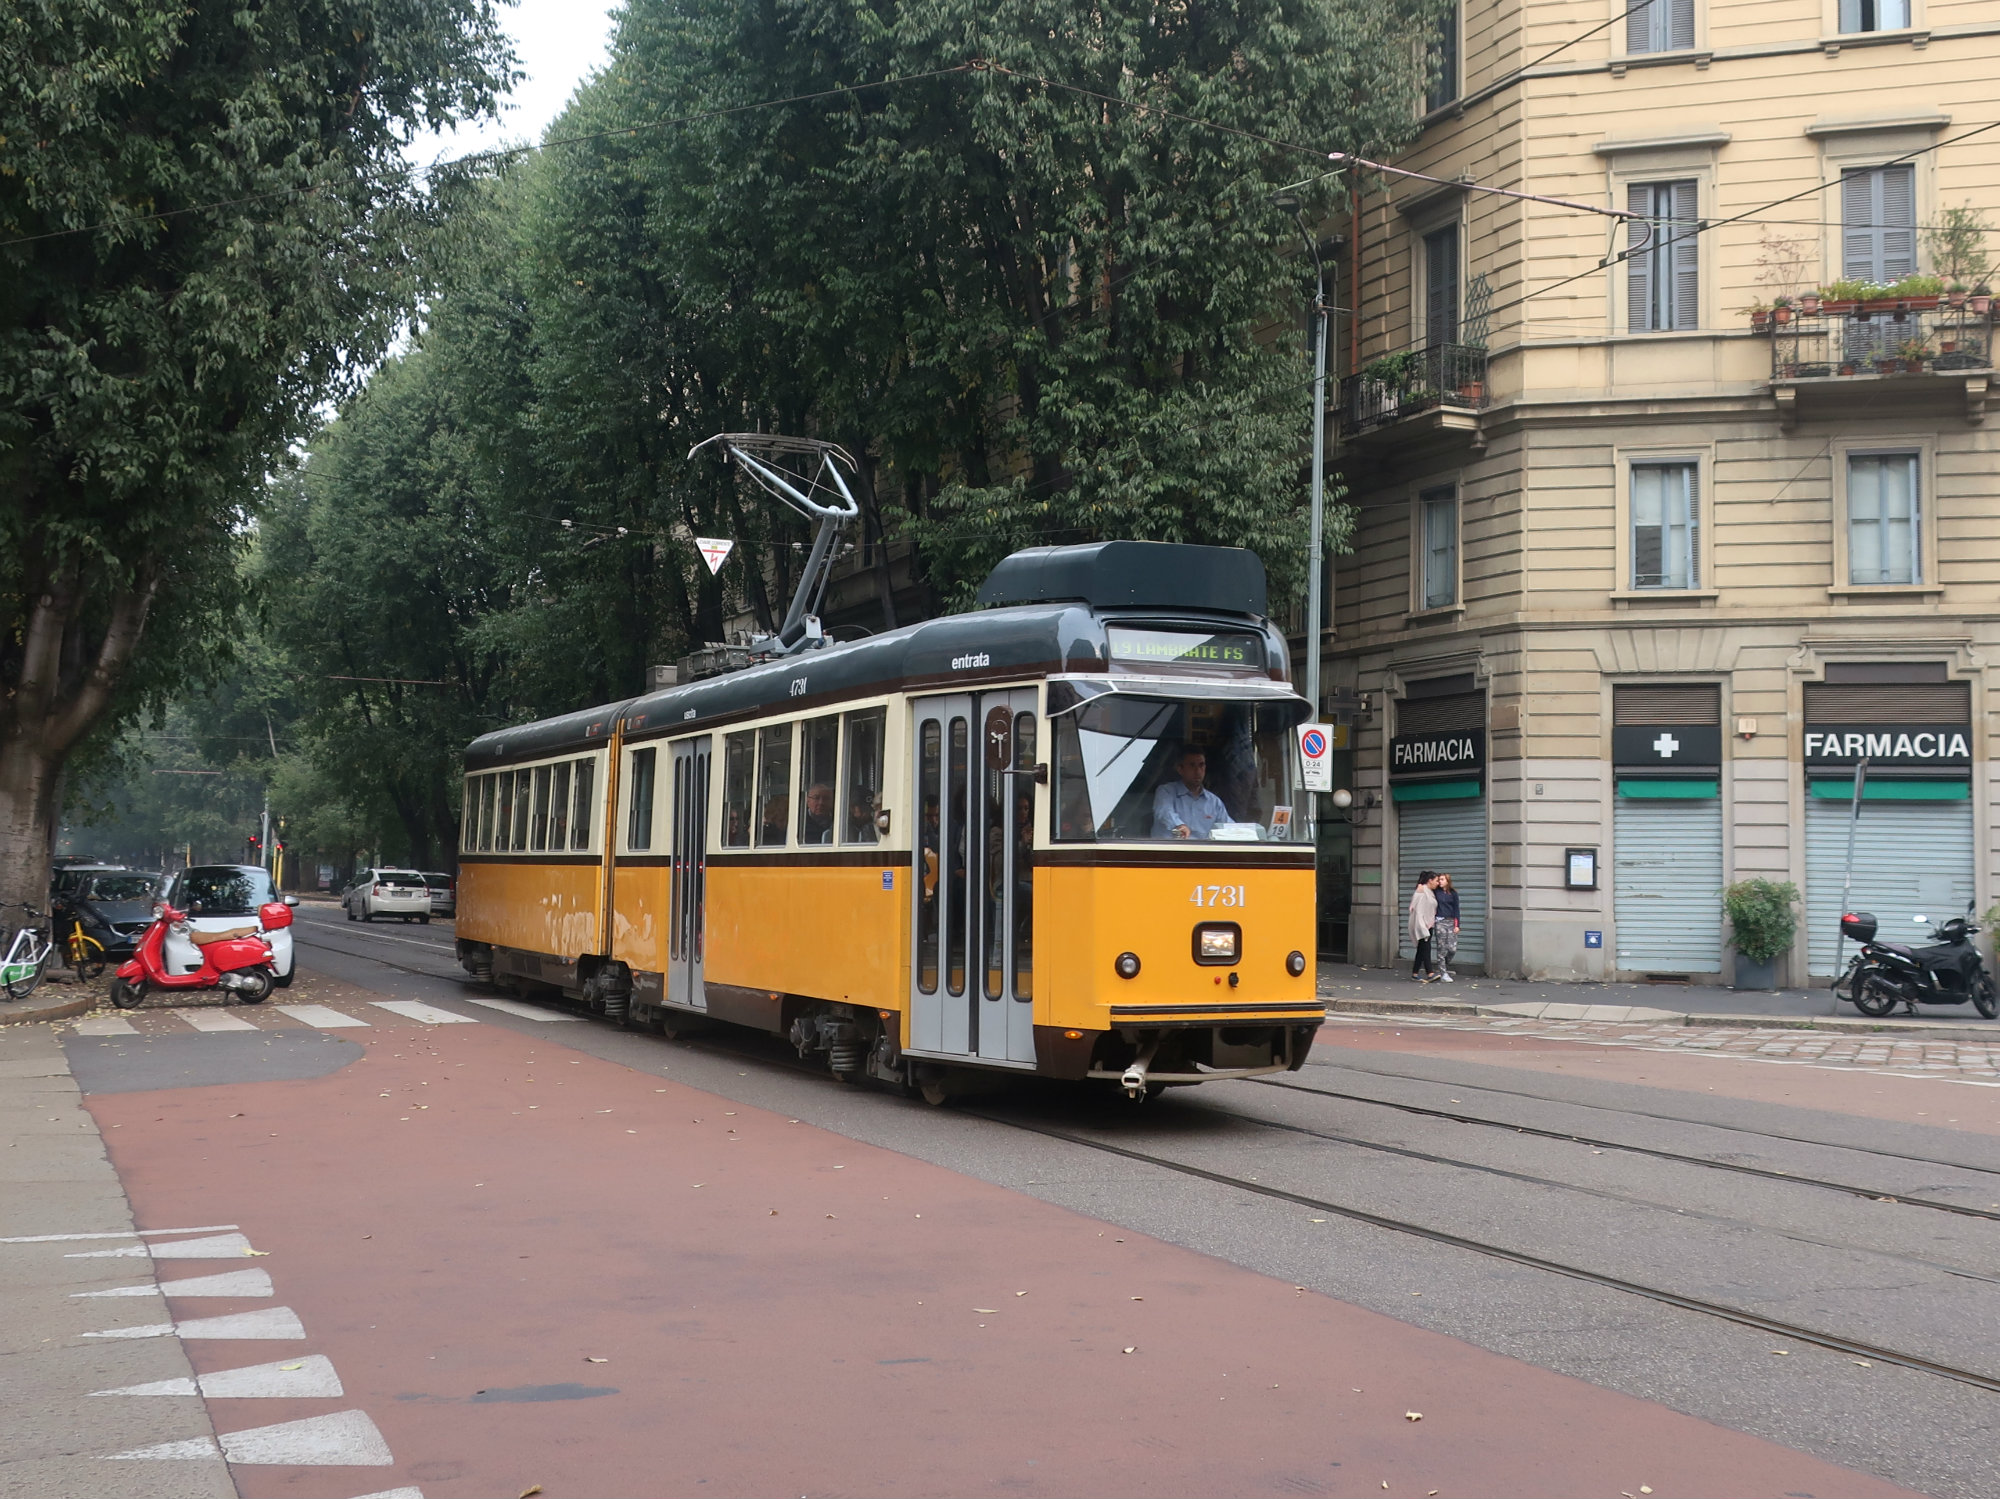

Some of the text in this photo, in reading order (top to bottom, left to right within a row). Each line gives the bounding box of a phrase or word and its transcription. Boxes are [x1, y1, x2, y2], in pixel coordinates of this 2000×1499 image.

[951, 652, 990, 669] entrata
[1136, 643, 1218, 659] LAMBRATE
[1223, 647, 1244, 660] FS
[789, 677, 807, 696] 4731
[1395, 738, 1475, 765] FARMACIA
[1805, 733, 1970, 757] FARMACIA
[1189, 885, 1245, 907] 4731
